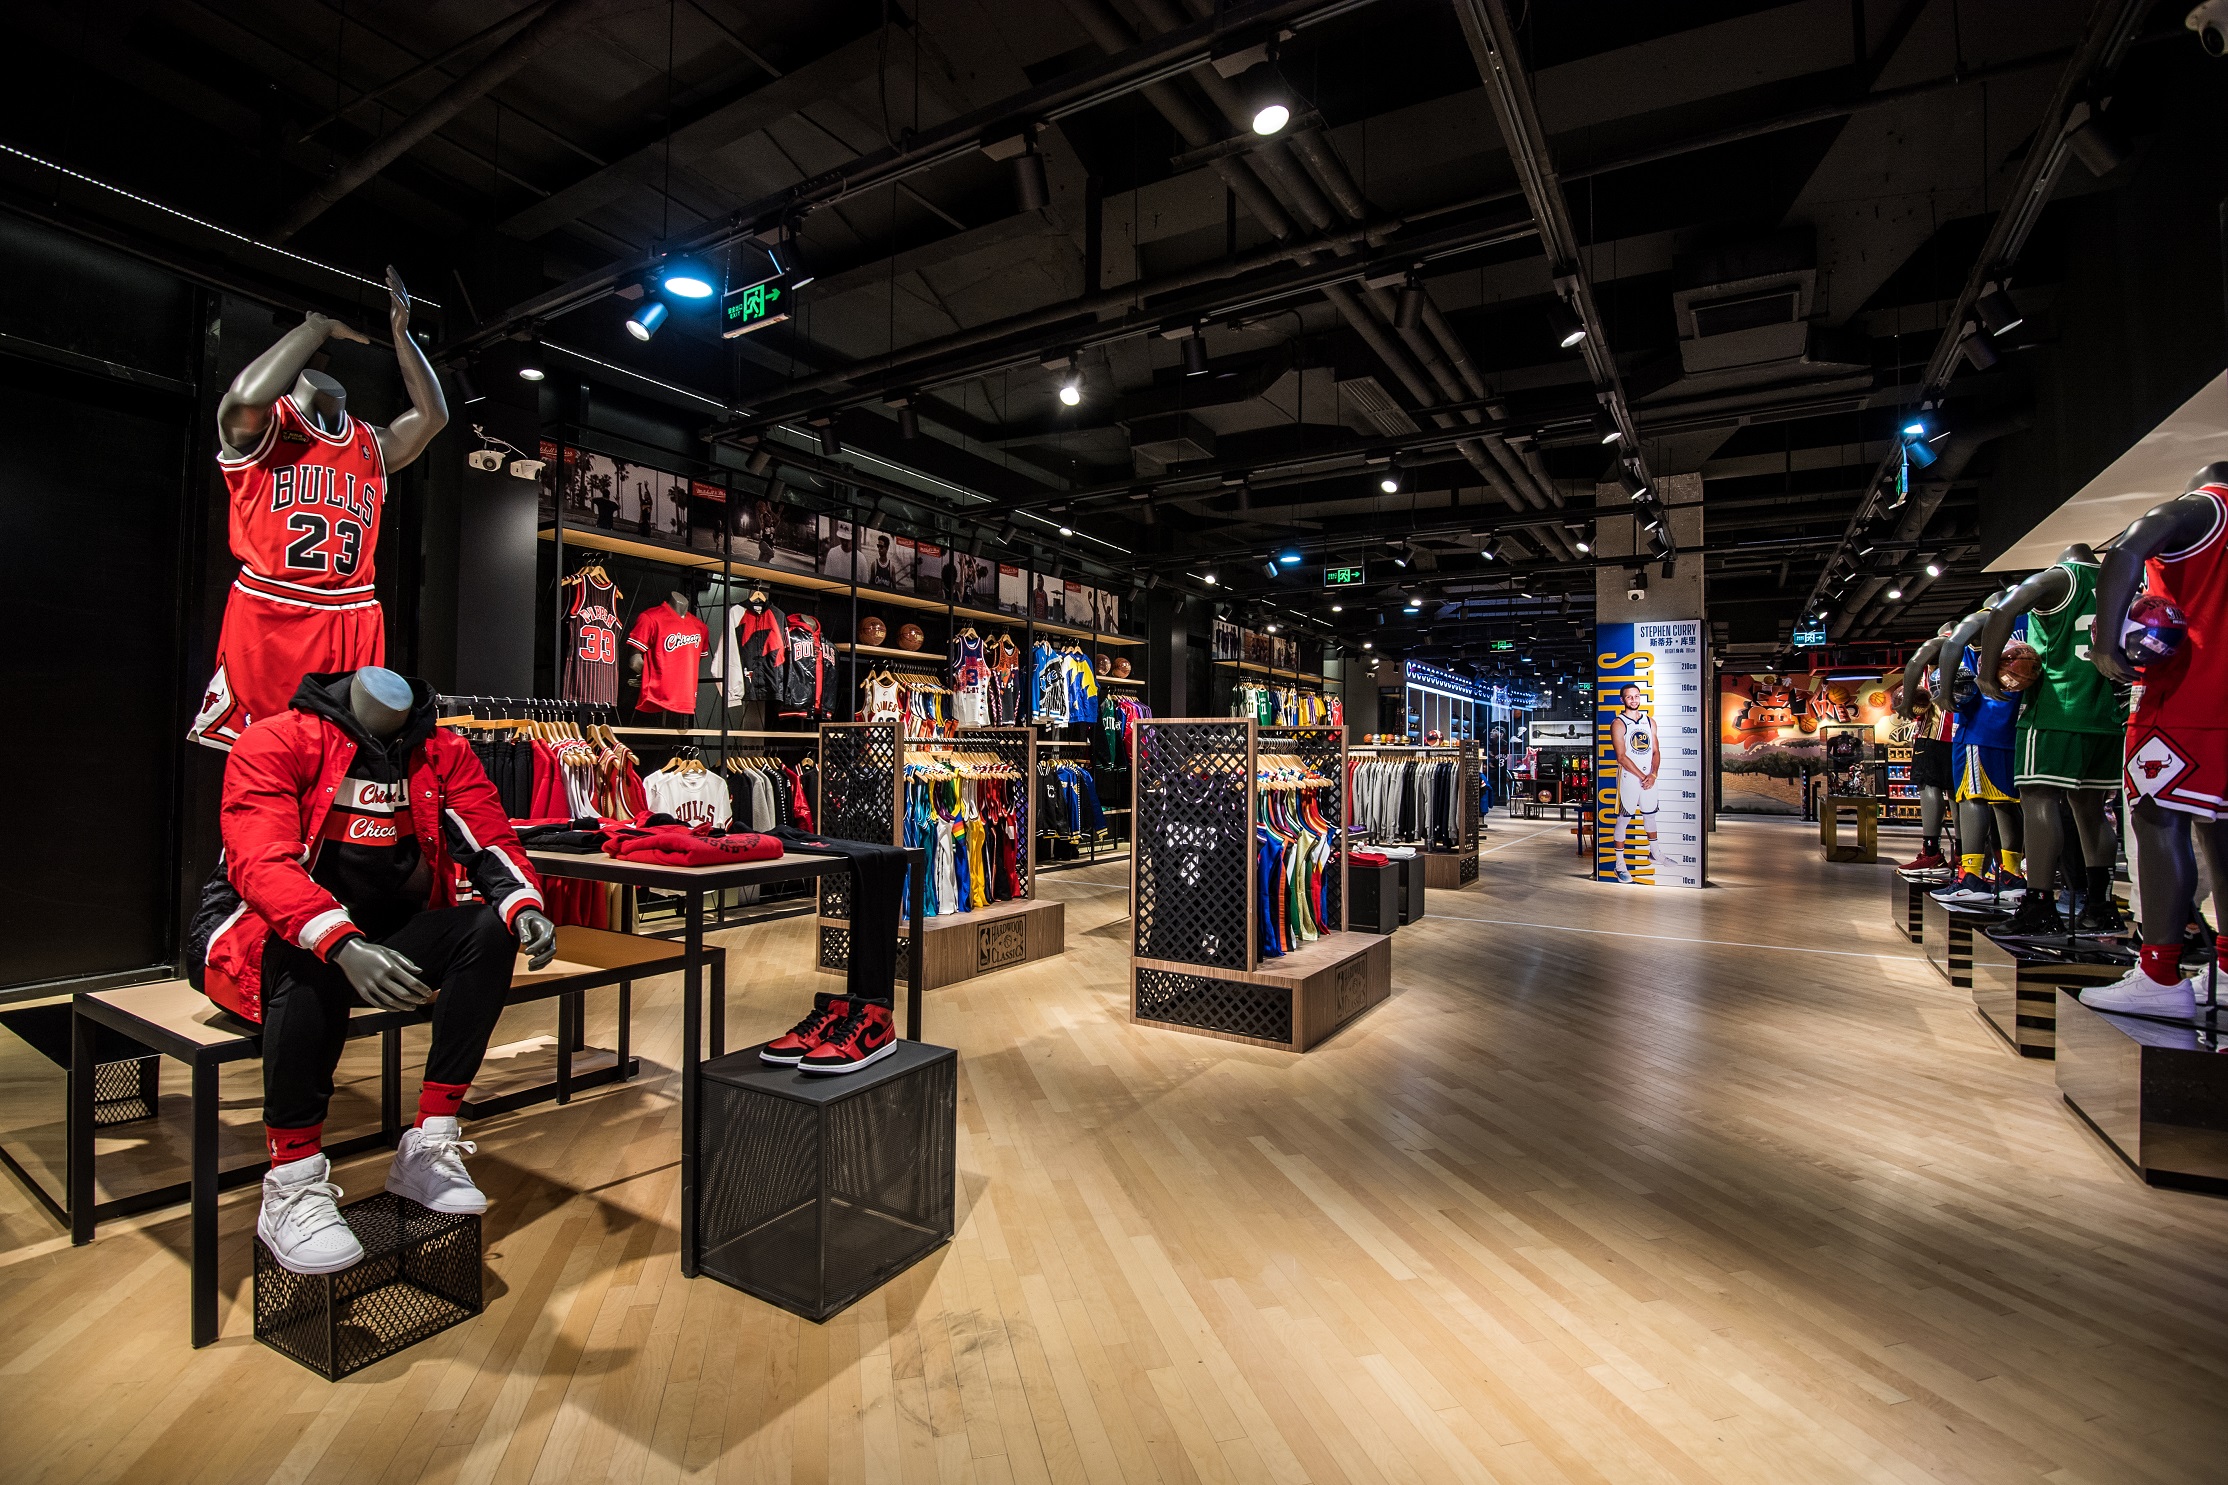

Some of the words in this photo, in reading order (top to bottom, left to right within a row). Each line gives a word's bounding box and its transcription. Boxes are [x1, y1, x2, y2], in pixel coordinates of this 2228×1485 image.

[271, 464, 376, 529] BULLS
[285, 511, 363, 576] 23
[579, 605, 617, 629] PIPPEN
[1640, 625, 1671, 638] STEPHEN
[1672, 624, 1697, 636] CURRY
[579, 624, 616, 664] 33
[664, 632, 702, 653] Chicag
[965, 668, 979, 686] 3
[1247, 701, 1254, 714] 11
[1682, 726, 1698, 734] 150cm
[1682, 769, 1697, 777] 110cm
[1682, 790, 1696, 798] 90cm
[675, 800, 715, 827] BULLS
[1682, 812, 1696, 820] 70cm
[349, 818, 397, 842] Chica
[1682, 833, 1697, 841] 50cm
[1682, 876, 1696, 885] 10cm
[991, 920, 1024, 946] HARDWOOD
[991, 940, 1024, 963] CLASSICS
